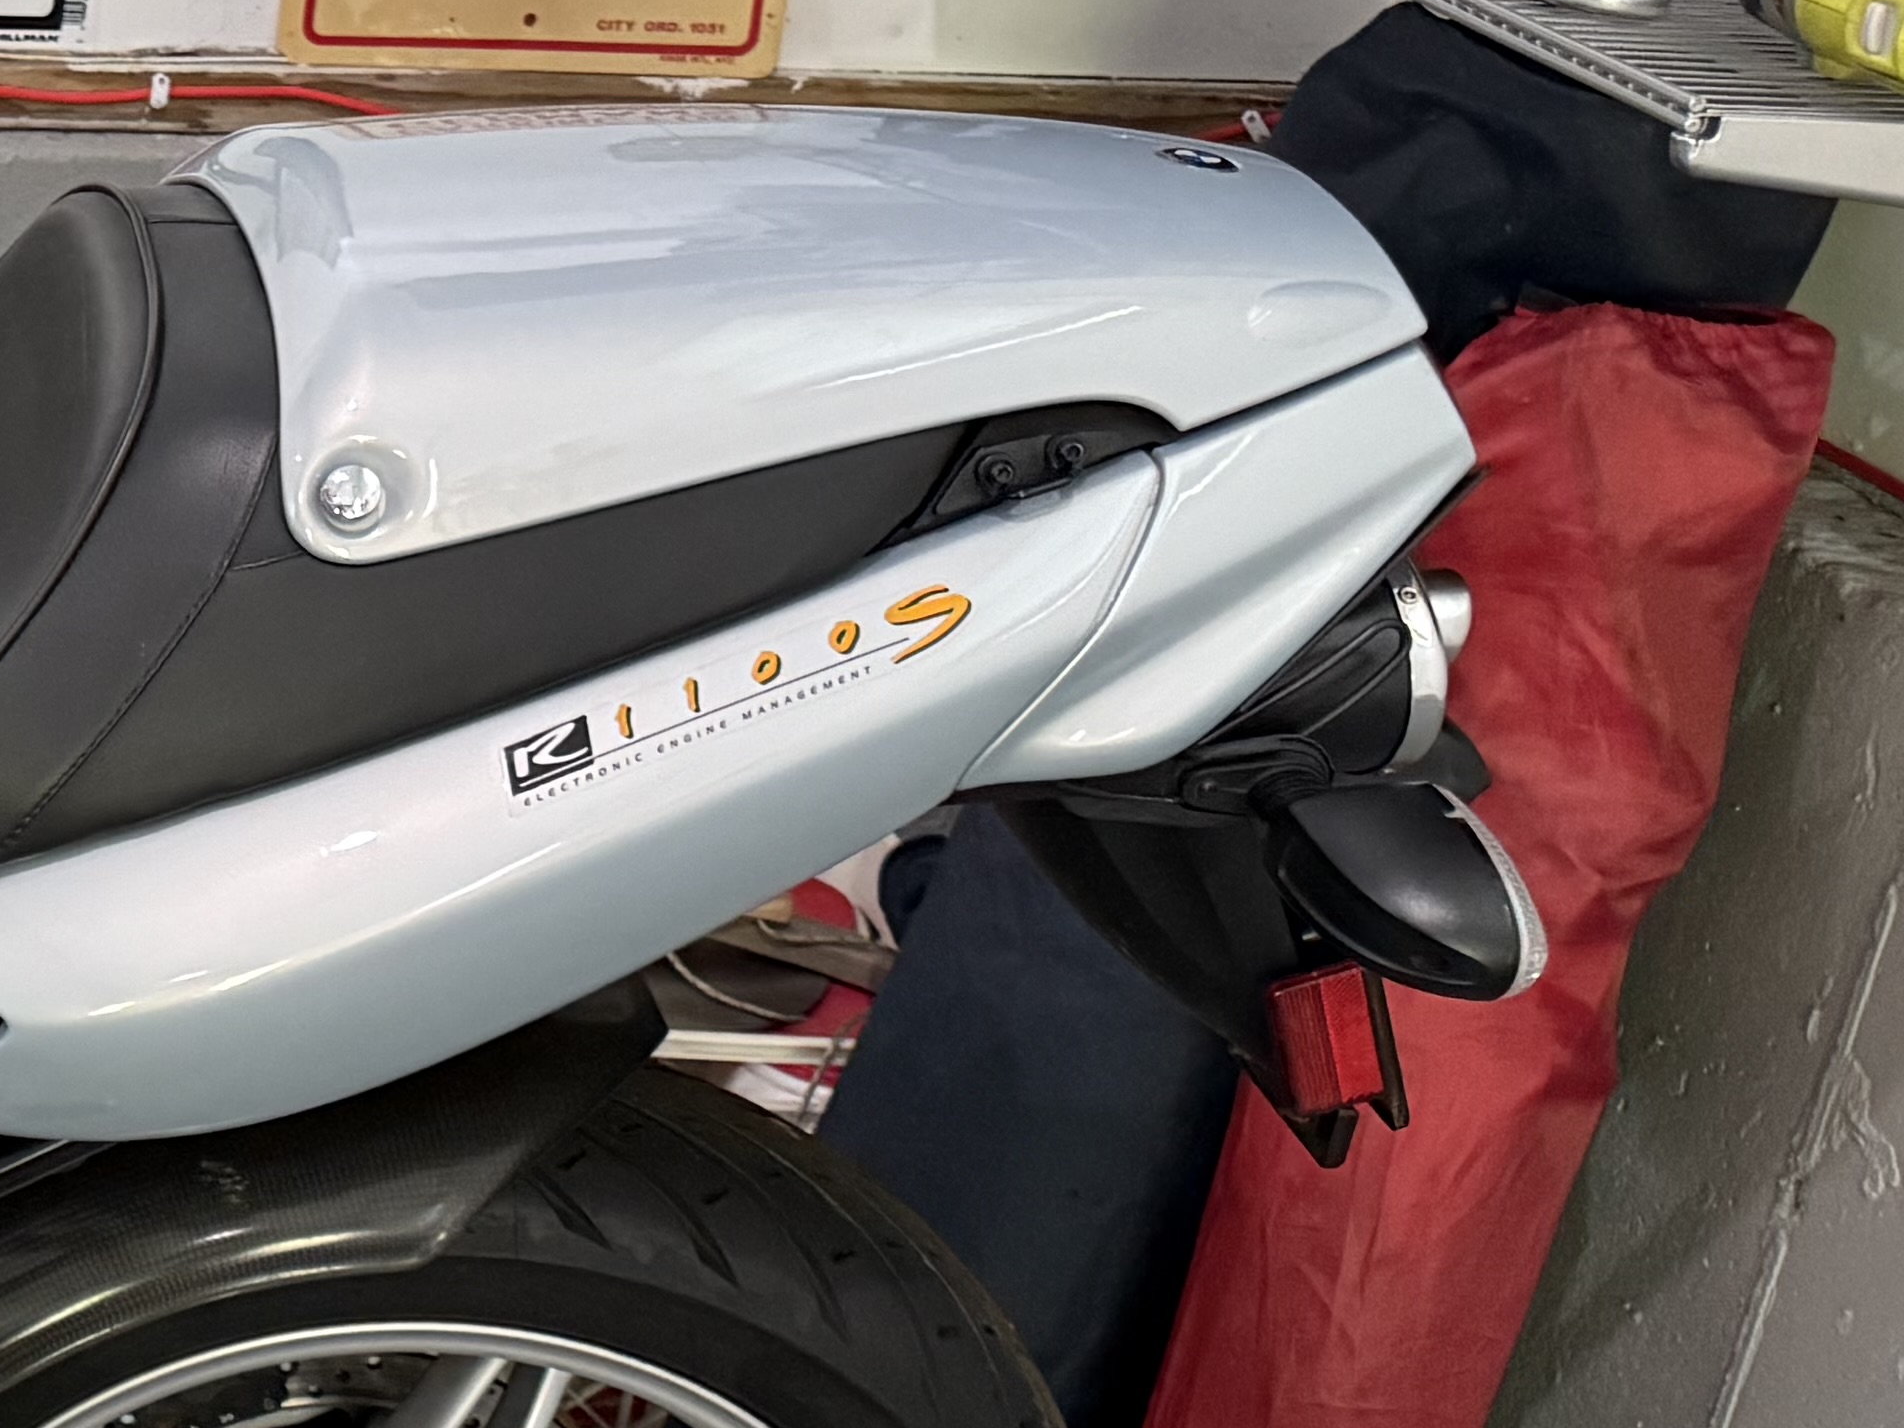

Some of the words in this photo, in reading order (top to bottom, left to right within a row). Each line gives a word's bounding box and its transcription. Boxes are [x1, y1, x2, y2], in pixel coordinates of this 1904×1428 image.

[596, 19, 635, 32] CITY
[523, 753, 643, 808] ELECTRONIC
[657, 720, 728, 754] ENGINE
[742, 665, 873, 722] MANAGEMENT
